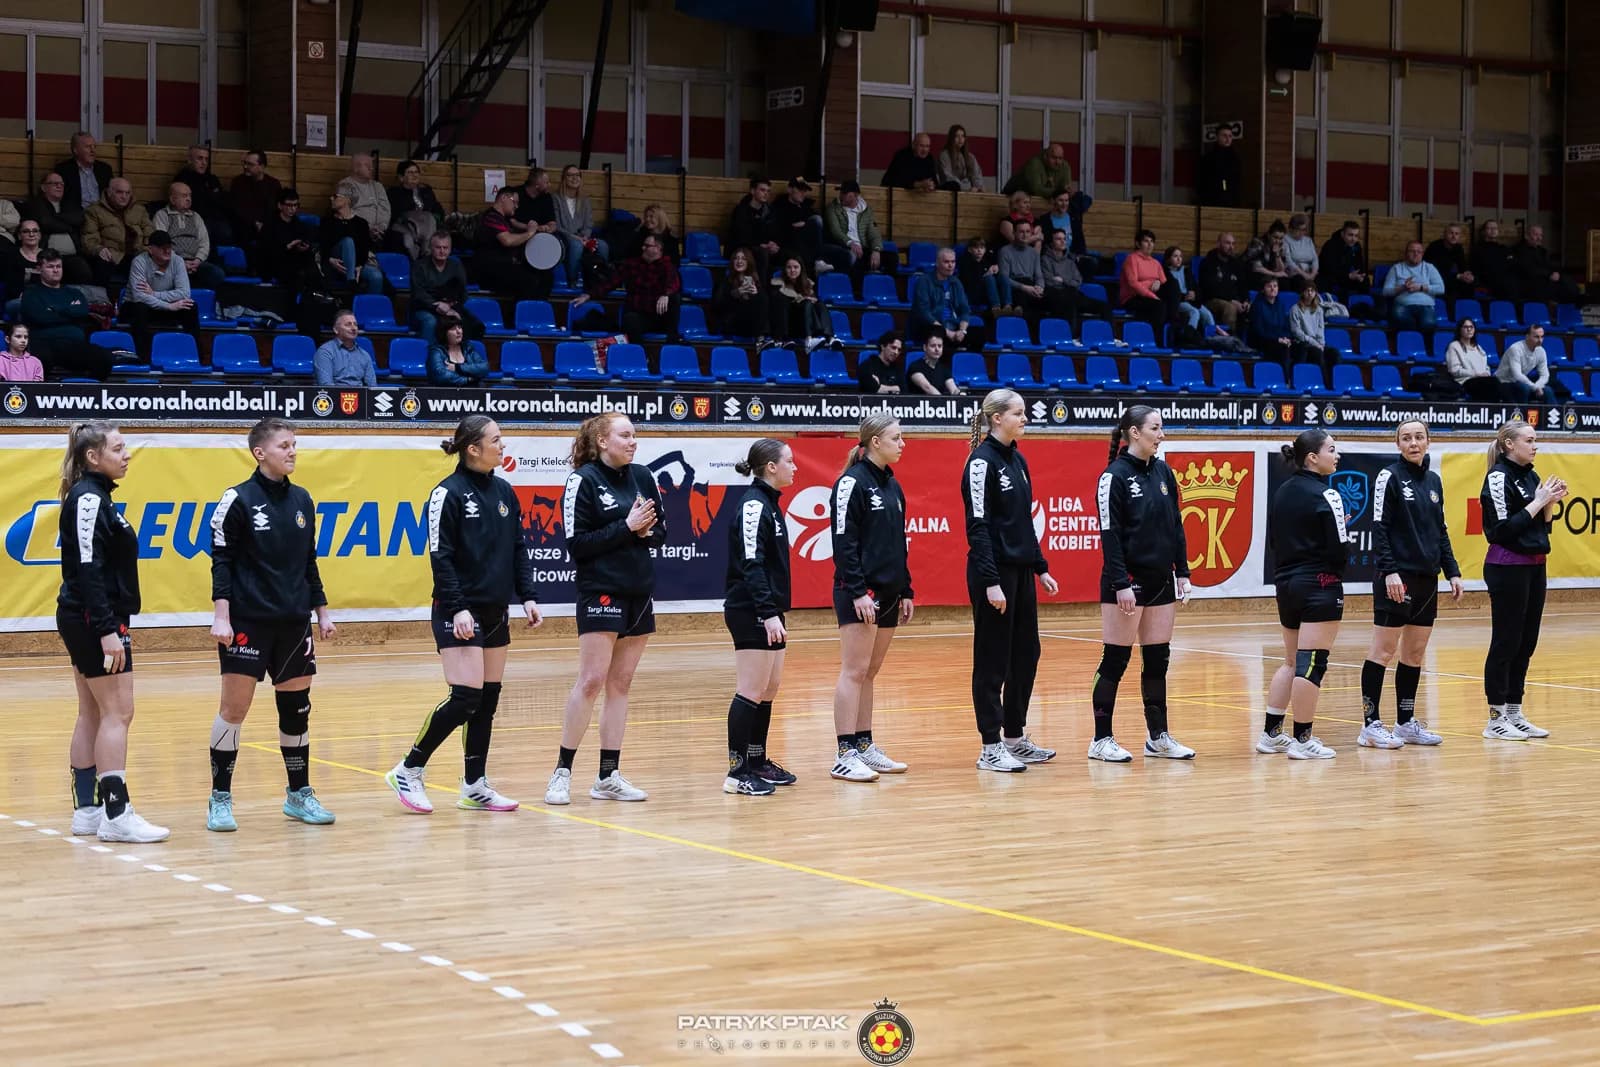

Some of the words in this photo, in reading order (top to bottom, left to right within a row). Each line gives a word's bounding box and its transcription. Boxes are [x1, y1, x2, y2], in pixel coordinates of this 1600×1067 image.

[36, 389, 304, 417] www.koronahandball.pl
[428, 393, 662, 420] www.koronahandball.pl
[1073, 401, 1257, 425] www.kahandball.pl
[518, 457, 539, 468] Targi
[541, 456, 568, 466] Kielce
[1049, 496, 1084, 512] LIGA
[904, 517, 951, 533] ALNA
[1049, 535, 1101, 550] KOBIET
[660, 542, 709, 561] targi...
